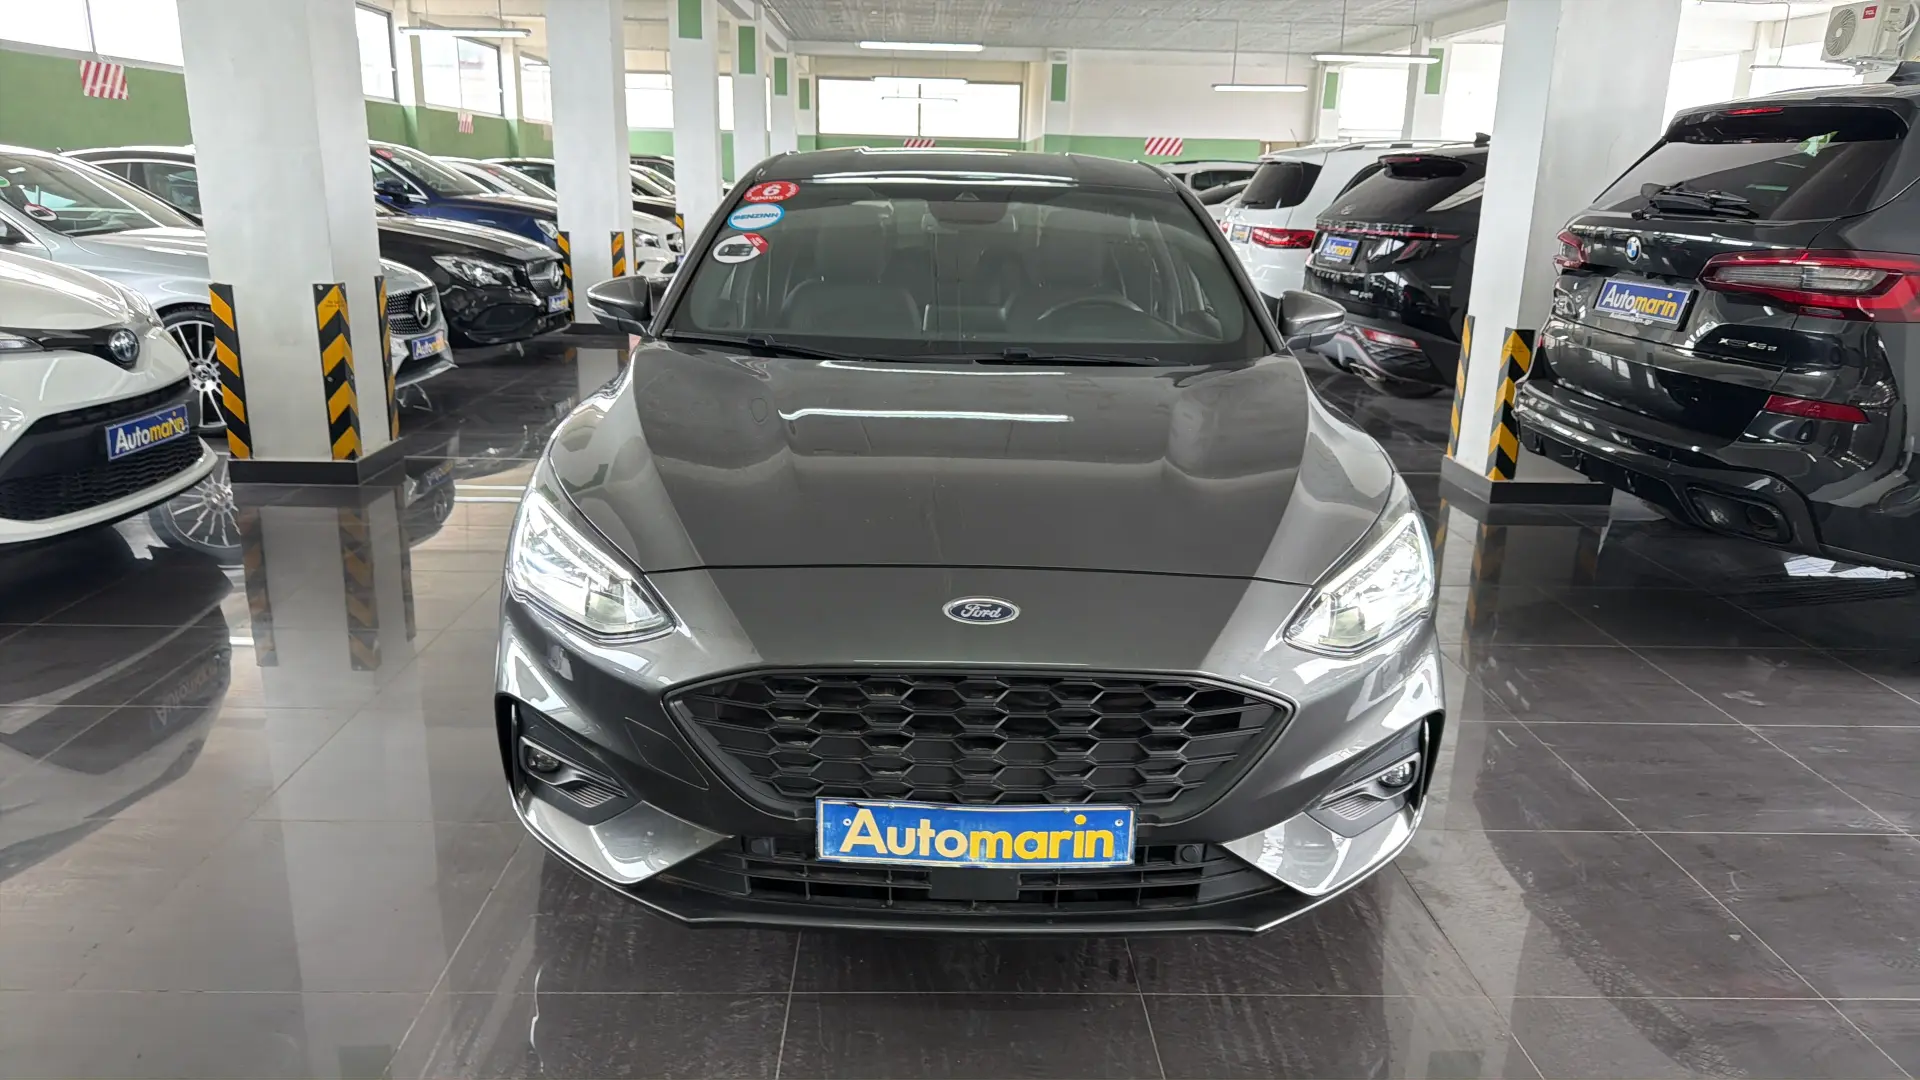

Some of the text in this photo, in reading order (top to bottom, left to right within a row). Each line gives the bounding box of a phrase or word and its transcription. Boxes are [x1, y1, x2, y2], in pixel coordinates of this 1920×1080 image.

[762, 184, 782, 196] 6
[1601, 284, 1678, 317] Automarin
[115, 411, 185, 454] Automarin
[960, 603, 1002, 618] Ford
[839, 808, 1114, 860] Automarin
